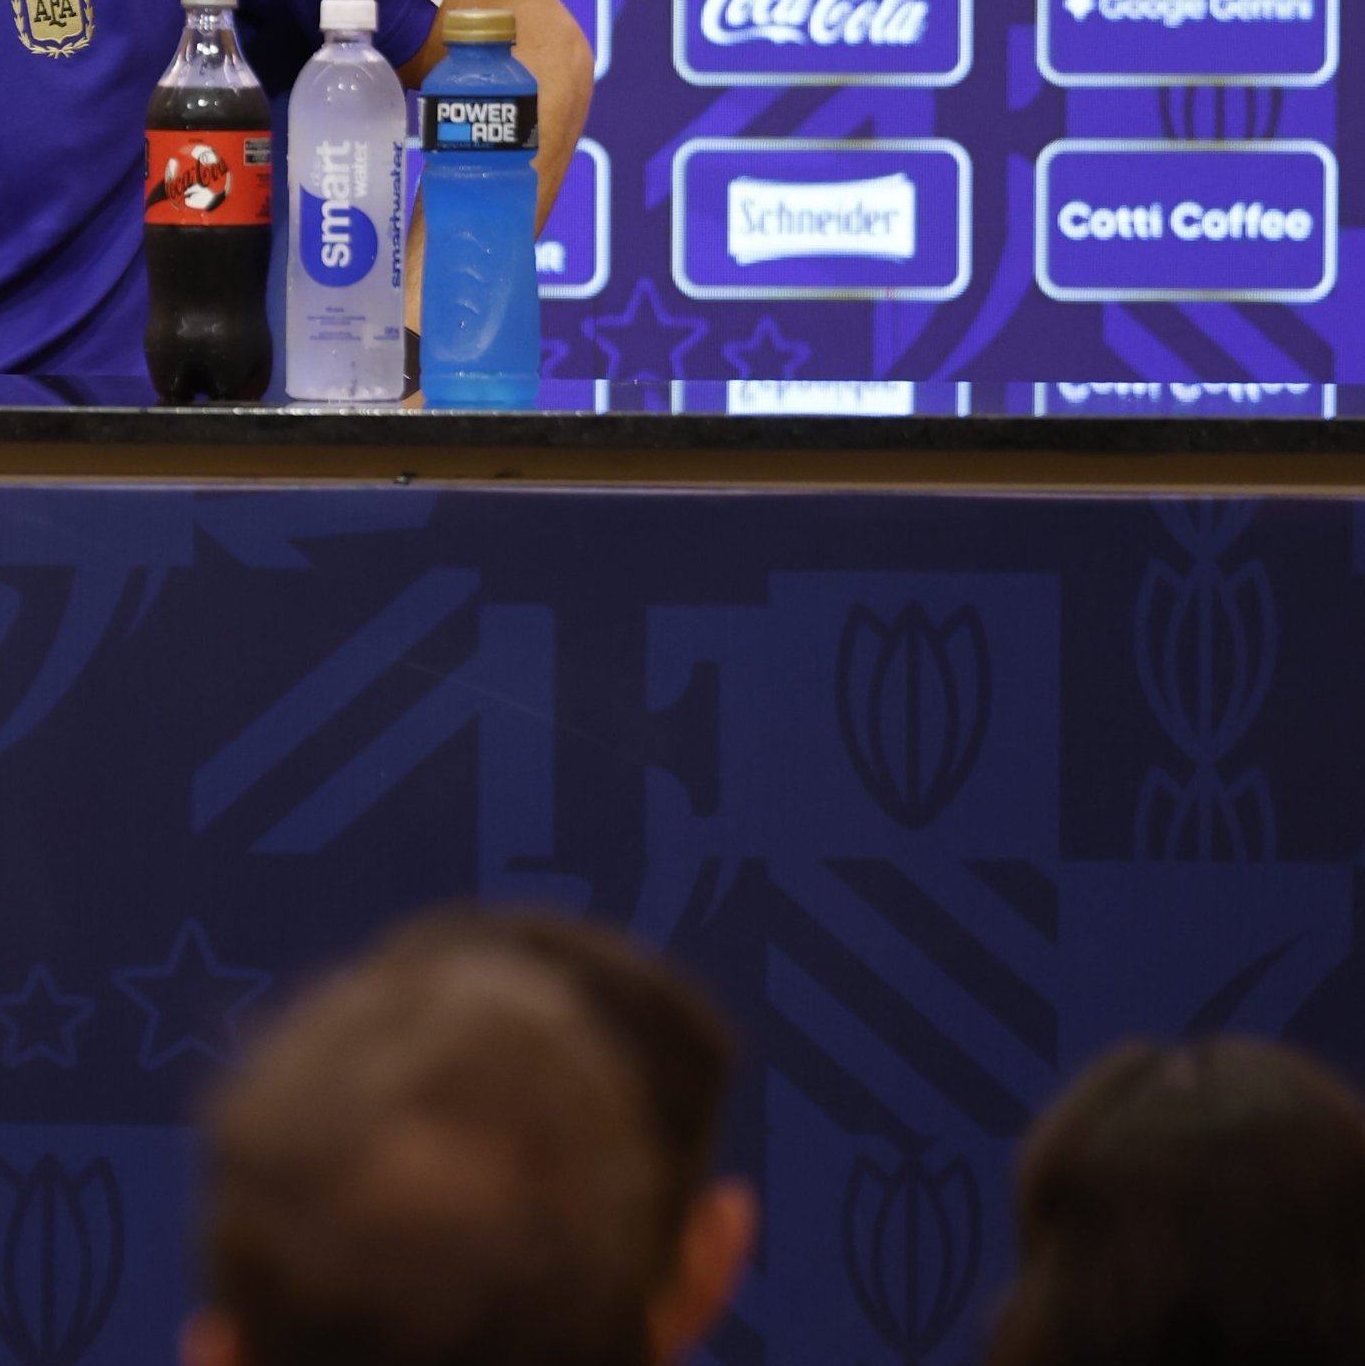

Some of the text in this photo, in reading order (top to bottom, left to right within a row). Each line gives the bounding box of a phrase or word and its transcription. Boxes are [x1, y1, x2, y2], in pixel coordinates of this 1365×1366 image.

[437, 103, 516, 123] POWER
[472, 123, 516, 143] ADE
[354, 141, 368, 198] water
[317, 140, 351, 267] smart
[738, 197, 898, 237] Schneider
[1058, 201, 1313, 241] Cotti Coffee
